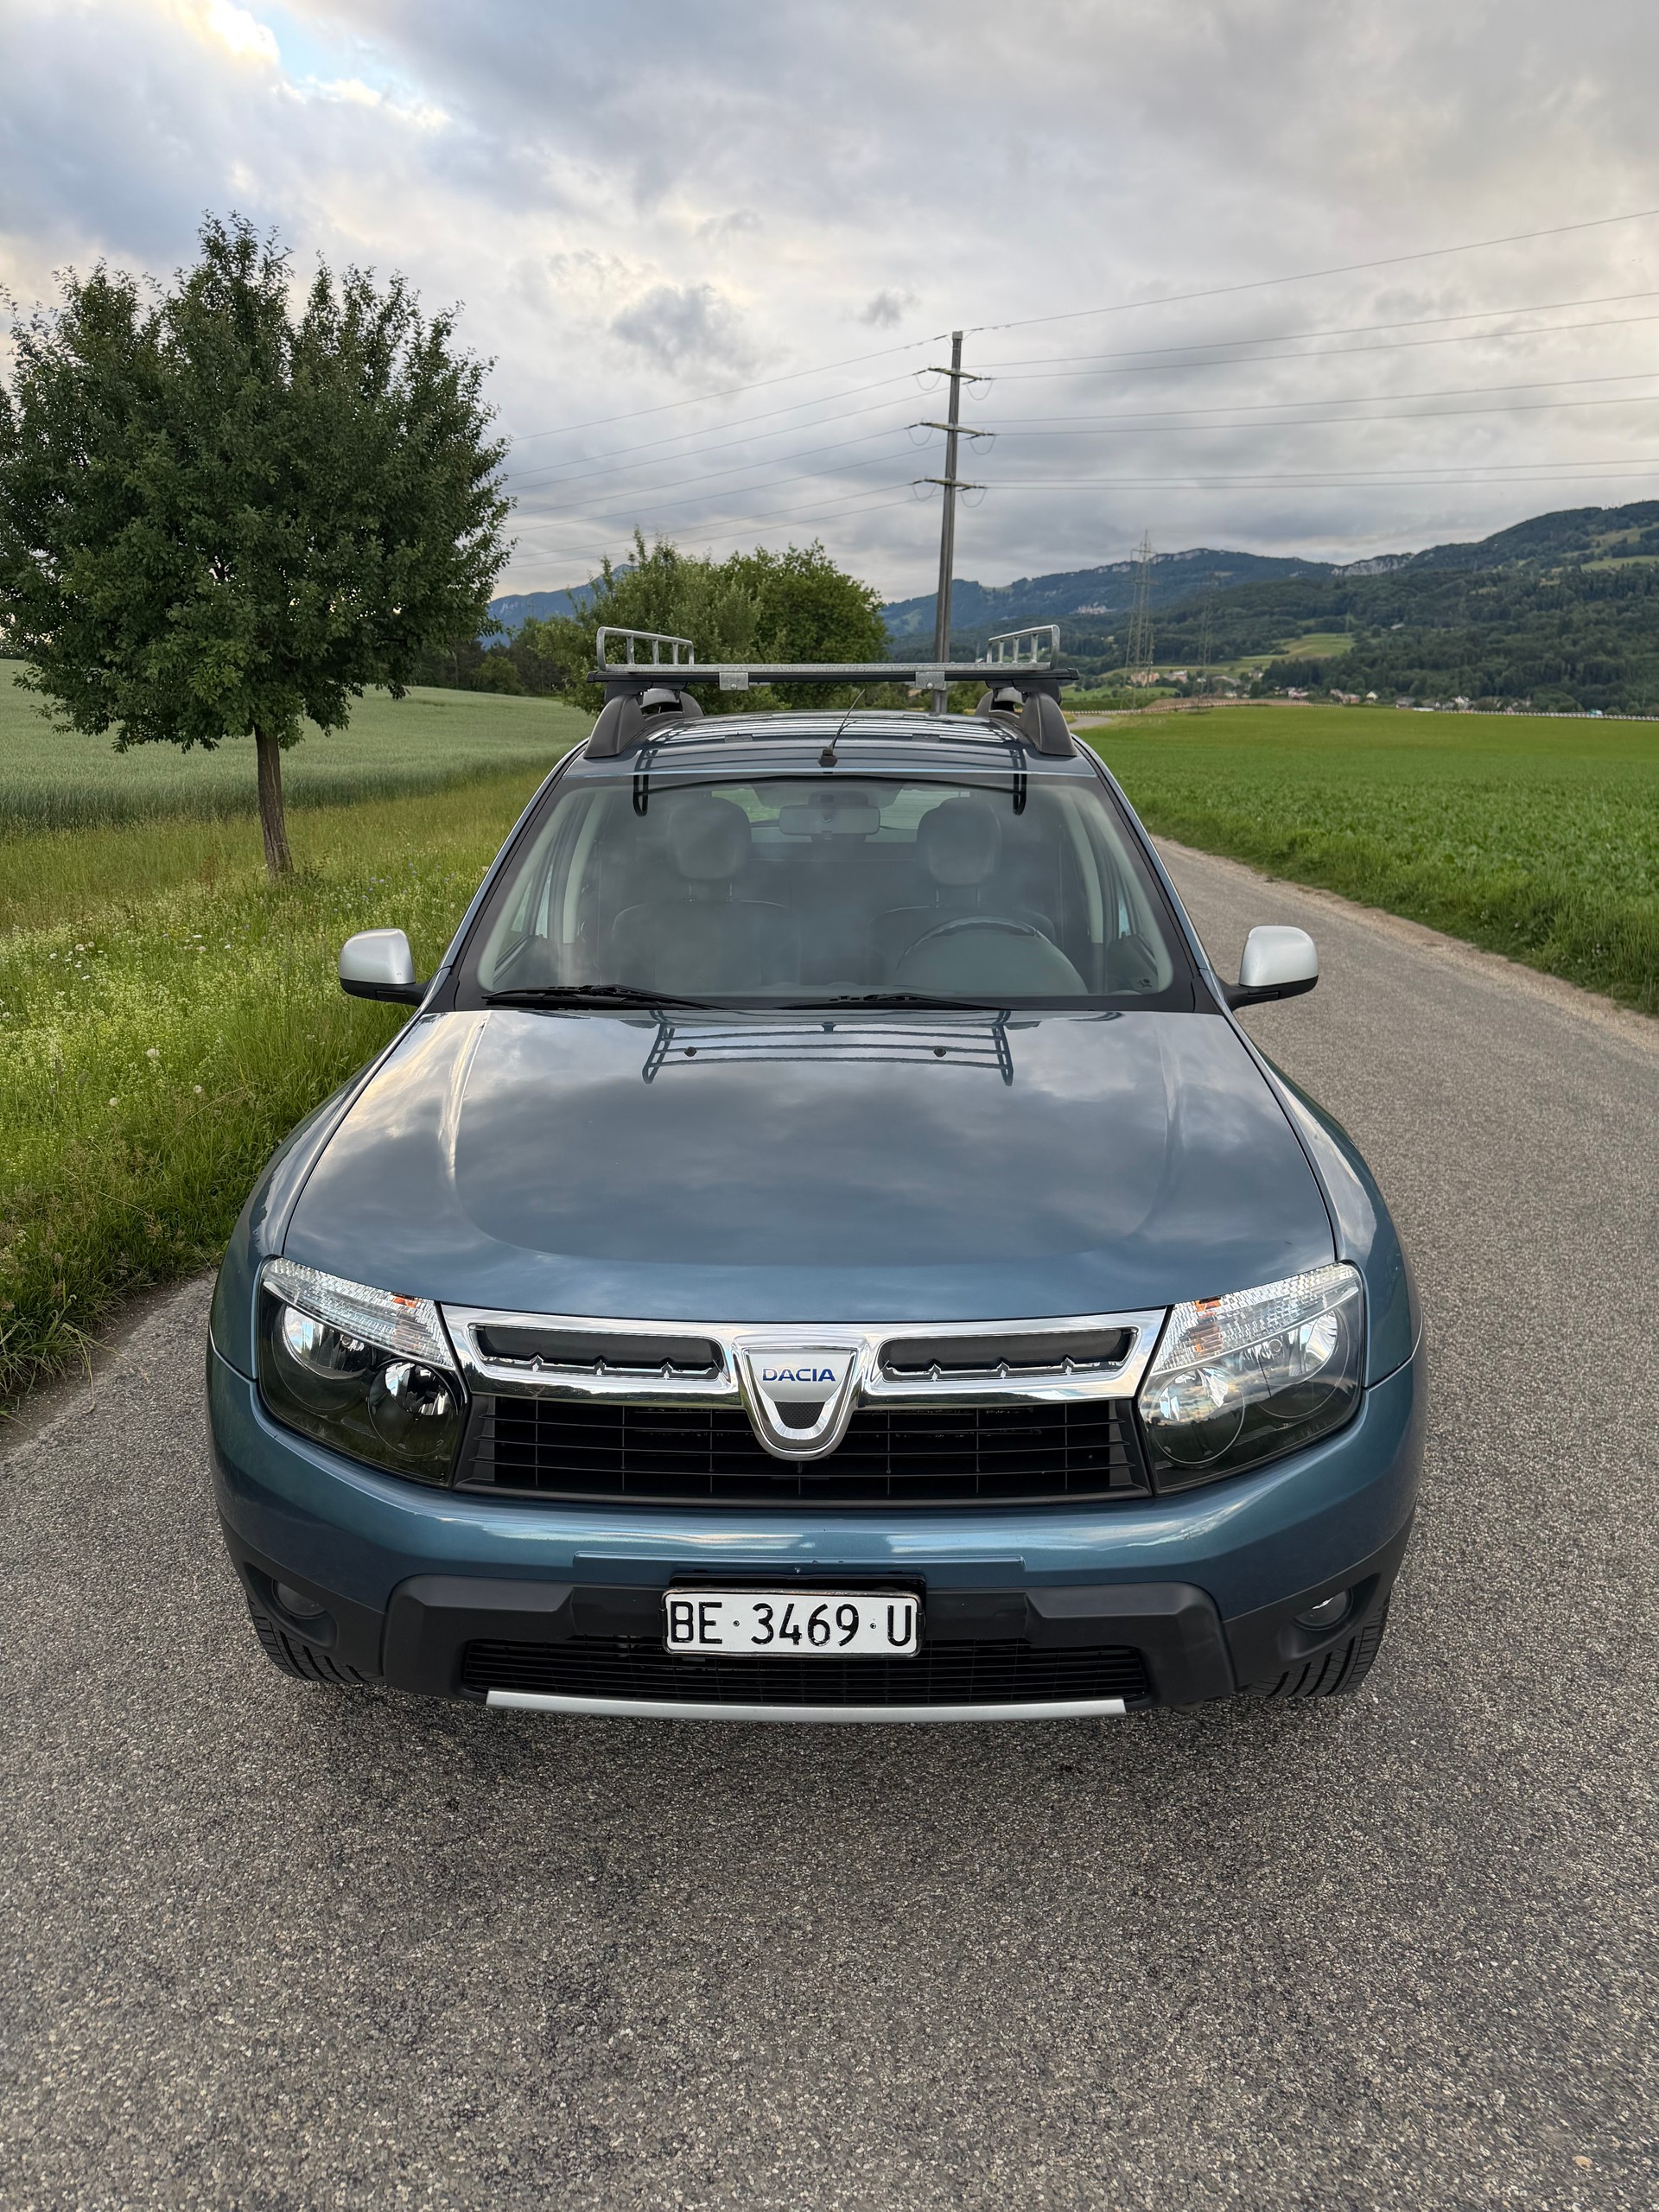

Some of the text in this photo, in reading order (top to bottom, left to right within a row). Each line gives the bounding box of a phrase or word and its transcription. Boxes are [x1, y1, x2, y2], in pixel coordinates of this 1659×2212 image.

[762, 1368, 836, 1382] DACIA
[670, 1601, 912, 1647] BE 3469 U
